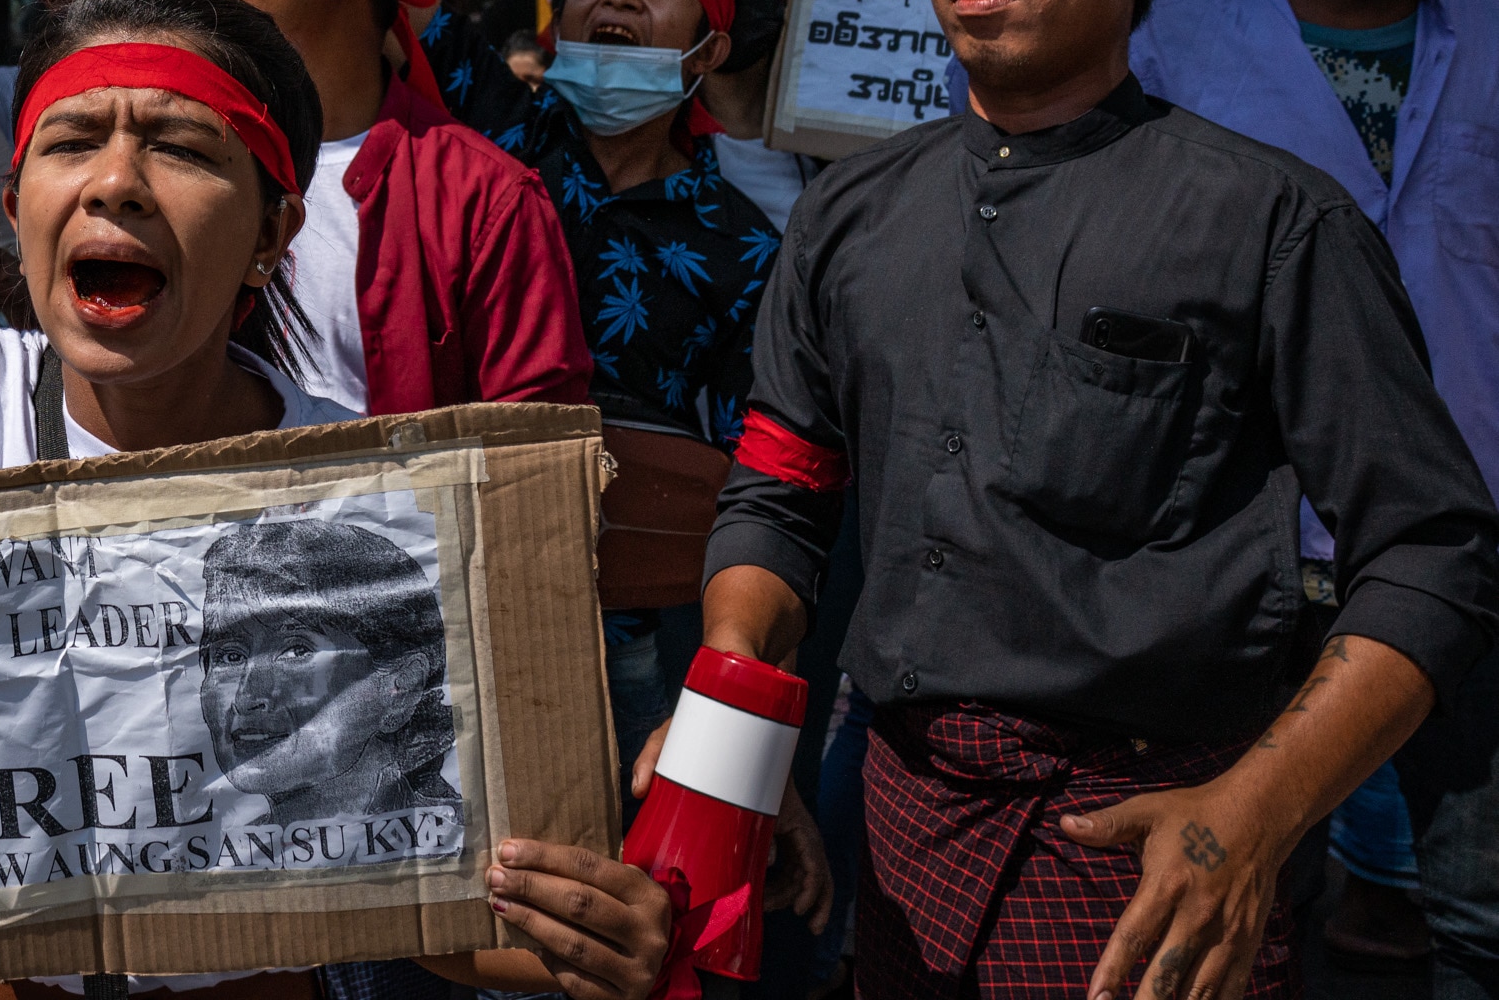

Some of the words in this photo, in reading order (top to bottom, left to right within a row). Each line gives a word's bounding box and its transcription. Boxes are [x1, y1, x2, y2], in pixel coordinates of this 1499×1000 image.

[807, 11, 953, 58] စစ်အာဏ
[7, 600, 196, 659] LEADER
[46, 840, 172, 884] AUNG
[188, 831, 277, 870] SAN
[290, 824, 346, 863] SU
